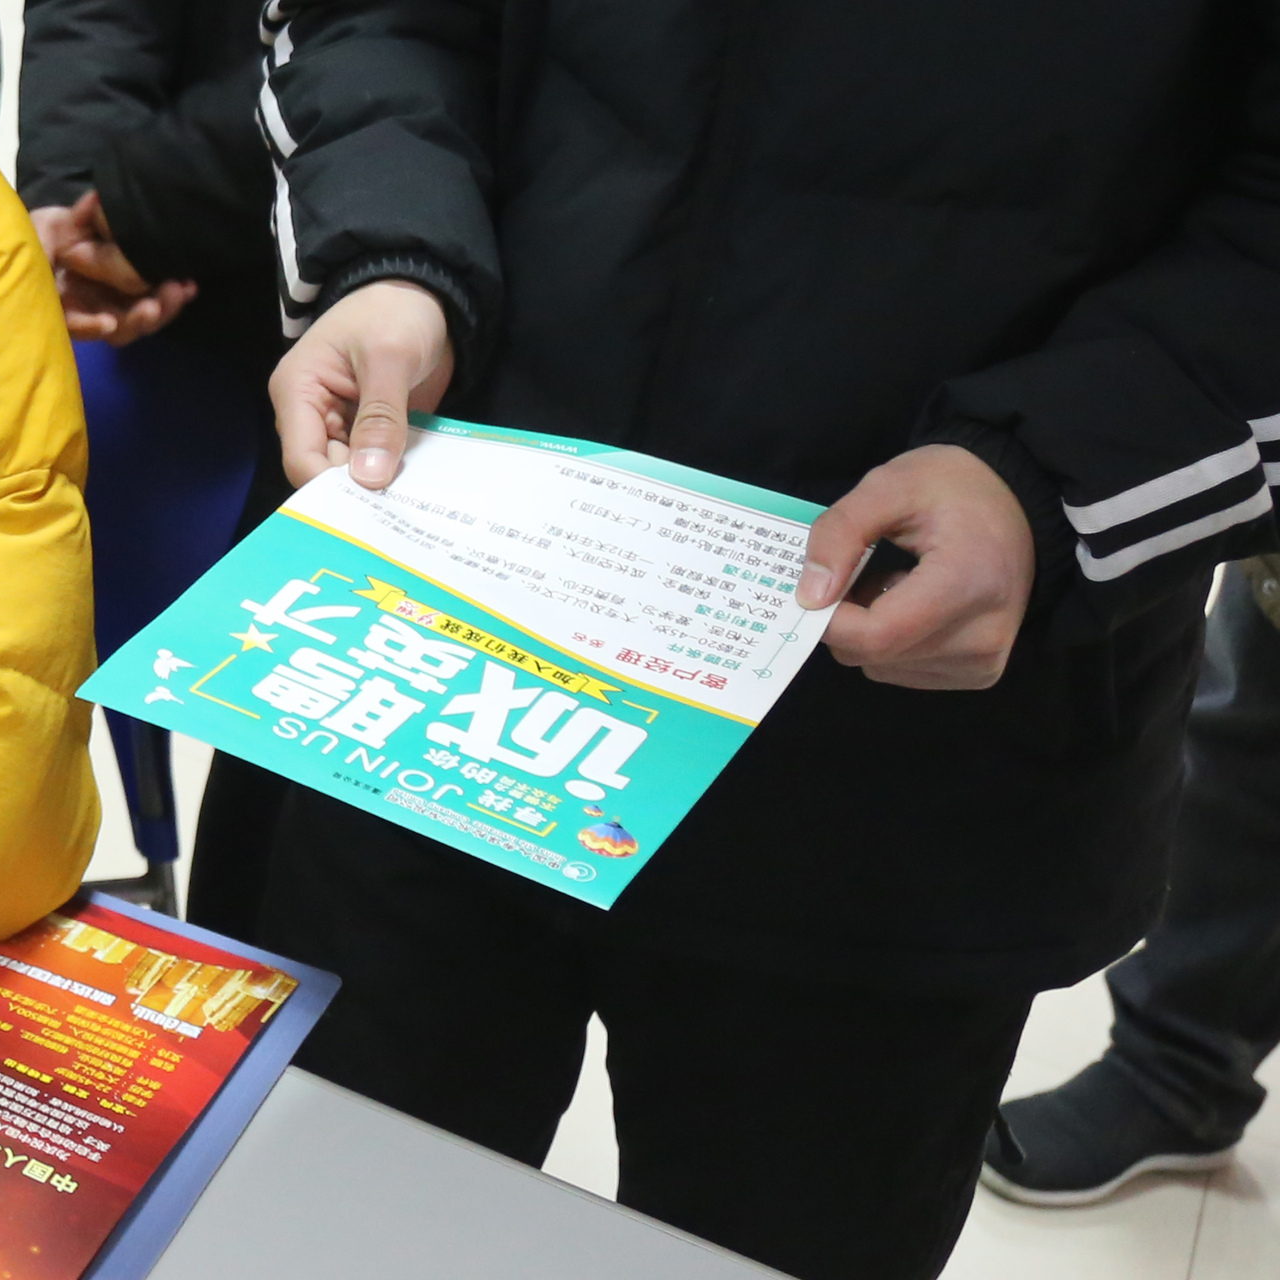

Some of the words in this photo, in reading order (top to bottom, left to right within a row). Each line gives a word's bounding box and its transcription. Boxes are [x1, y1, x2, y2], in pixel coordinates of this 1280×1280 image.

[718, 563, 797, 594] 薪酬待遇
[692, 603, 770, 634] 福利待遇
[389, 598, 576, 686] 加入我们成就梦想
[568, 630, 606, 648] 多名
[663, 641, 742, 671] 招聘条件
[613, 646, 731, 691] 客户经理
[265, 714, 344, 755] US
[340, 745, 469, 806] JOIN
[419, 745, 499, 786] 的你
[473, 788, 551, 828] 寻找
